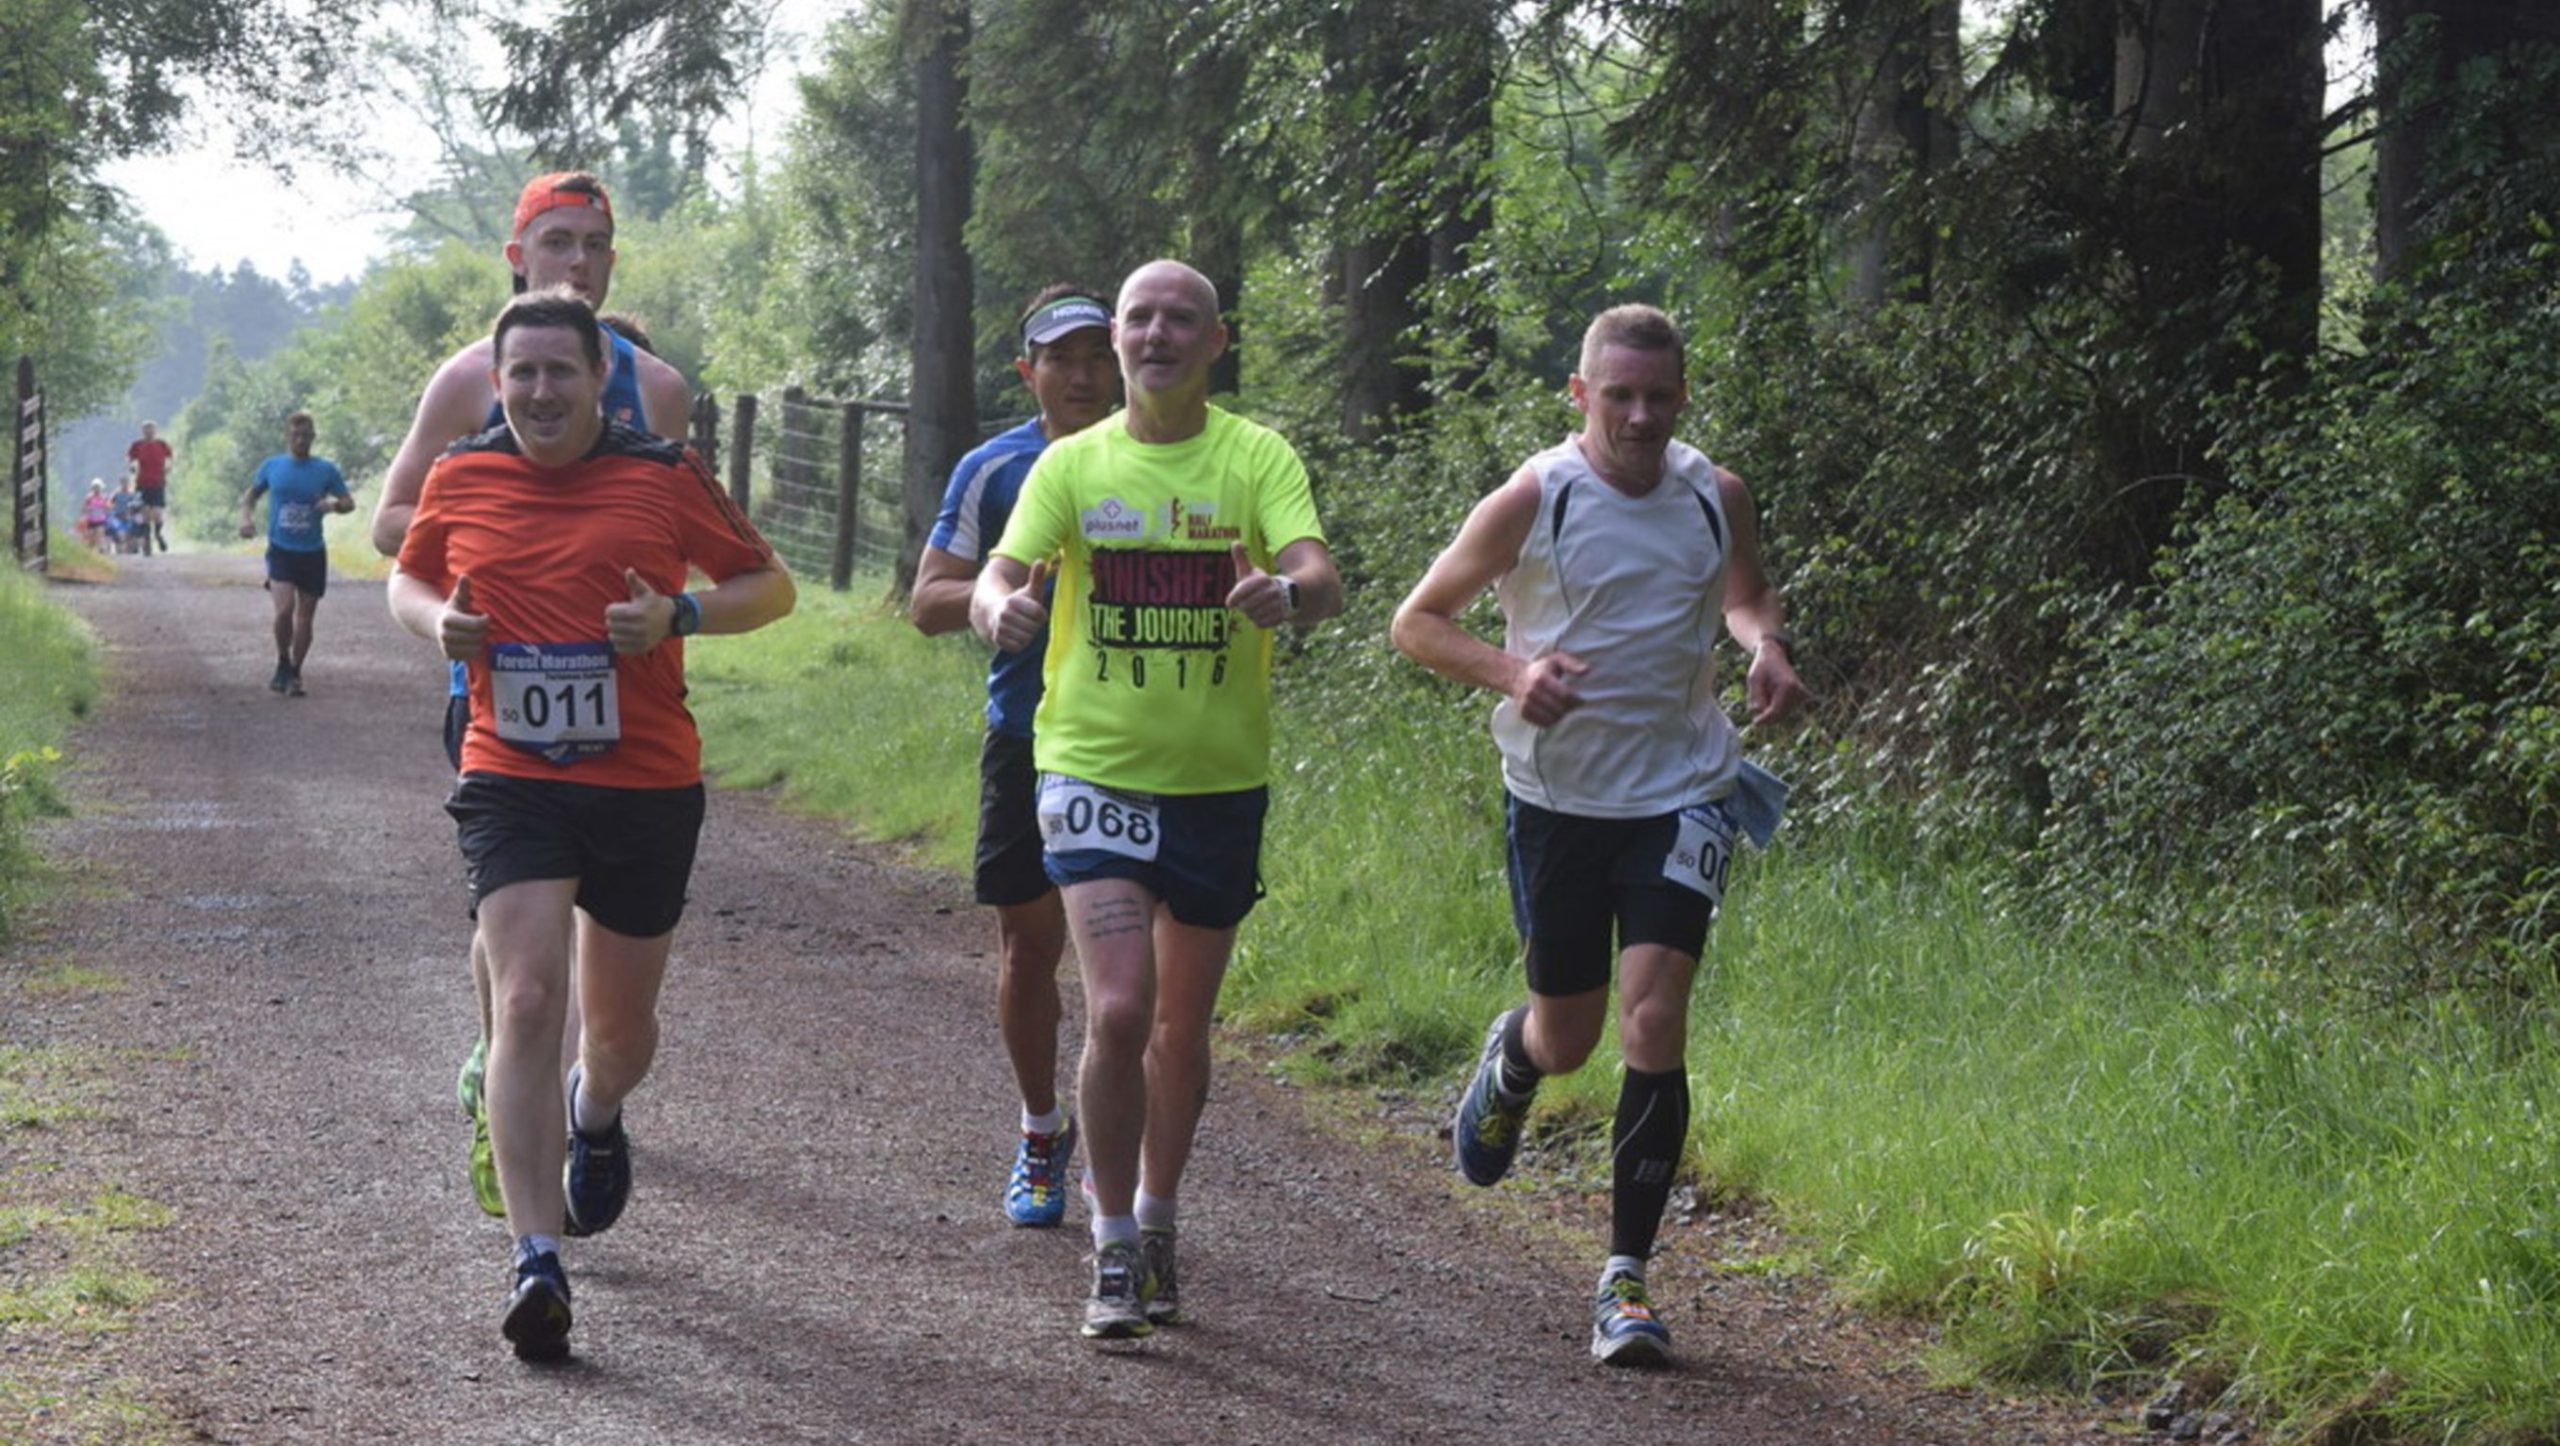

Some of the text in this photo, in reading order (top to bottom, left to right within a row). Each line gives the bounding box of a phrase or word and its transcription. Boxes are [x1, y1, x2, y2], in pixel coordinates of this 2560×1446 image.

[1085, 518, 1140, 533] plusnet
[1092, 604, 1233, 644] THE JOURNEY
[496, 653, 609, 669] Forest Marathon
[523, 683, 604, 728] 011
[1066, 796, 1153, 846] 068
